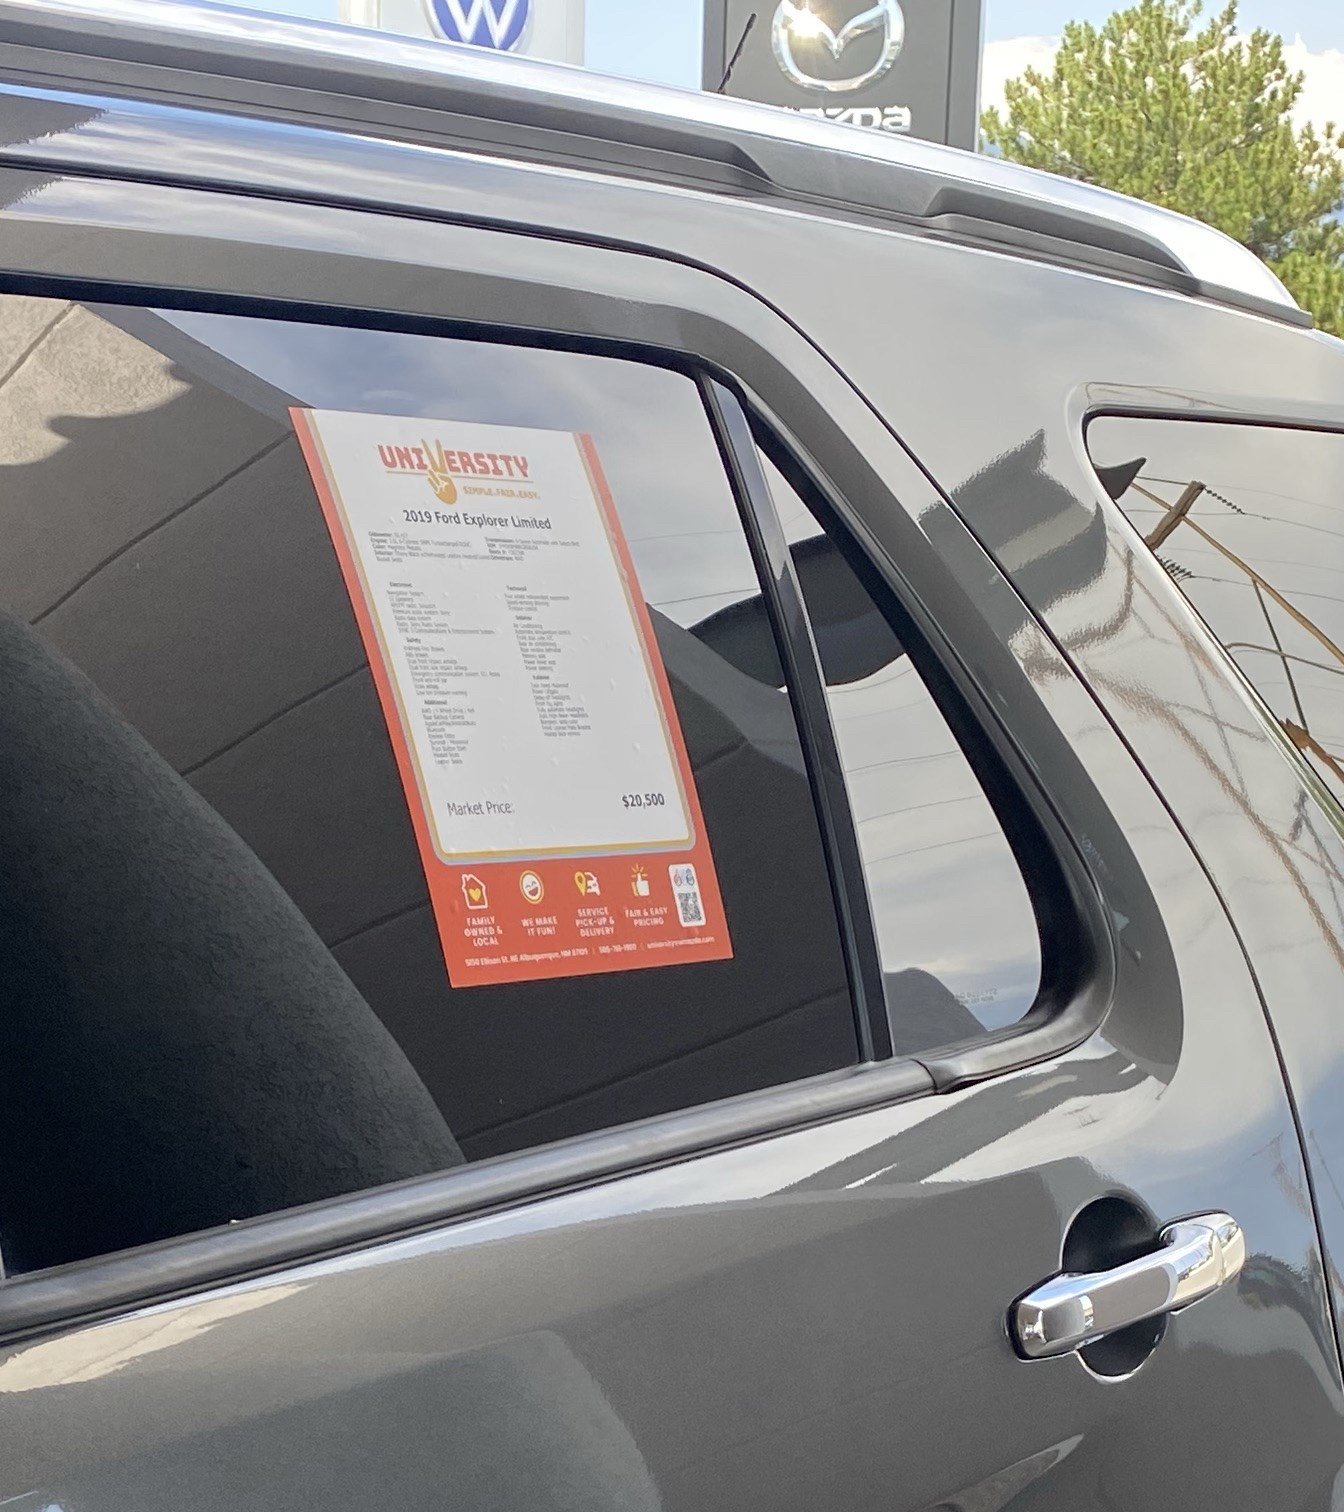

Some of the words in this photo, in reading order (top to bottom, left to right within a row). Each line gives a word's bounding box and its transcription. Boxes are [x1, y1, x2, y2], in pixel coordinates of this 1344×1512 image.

[403, 510, 432, 523] 2019
[435, 511, 460, 524] Ford
[463, 513, 509, 529] Explorer
[511, 515, 552, 530] Limited
[621, 793, 665, 809] $20,500
[446, 802, 483, 817] Market
[487, 801, 515, 816] Price:
[577, 906, 609, 917] SERVICE
[625, 909, 642, 918] FAIR
[649, 906, 668, 916] EASY
[466, 916, 495, 926] FAMILY
[521, 918, 534, 928] WE
[535, 915, 558, 926] MAKE
[575, 917, 608, 928] PICK-UP
[633, 917, 664, 927] PRICING
[464, 926, 495, 937] OWNED
[527, 927, 536, 936] IT
[537, 926, 556, 936] FUN!
[579, 926, 614, 937] DELIVERY
[472, 936, 499, 947] LOCAL
